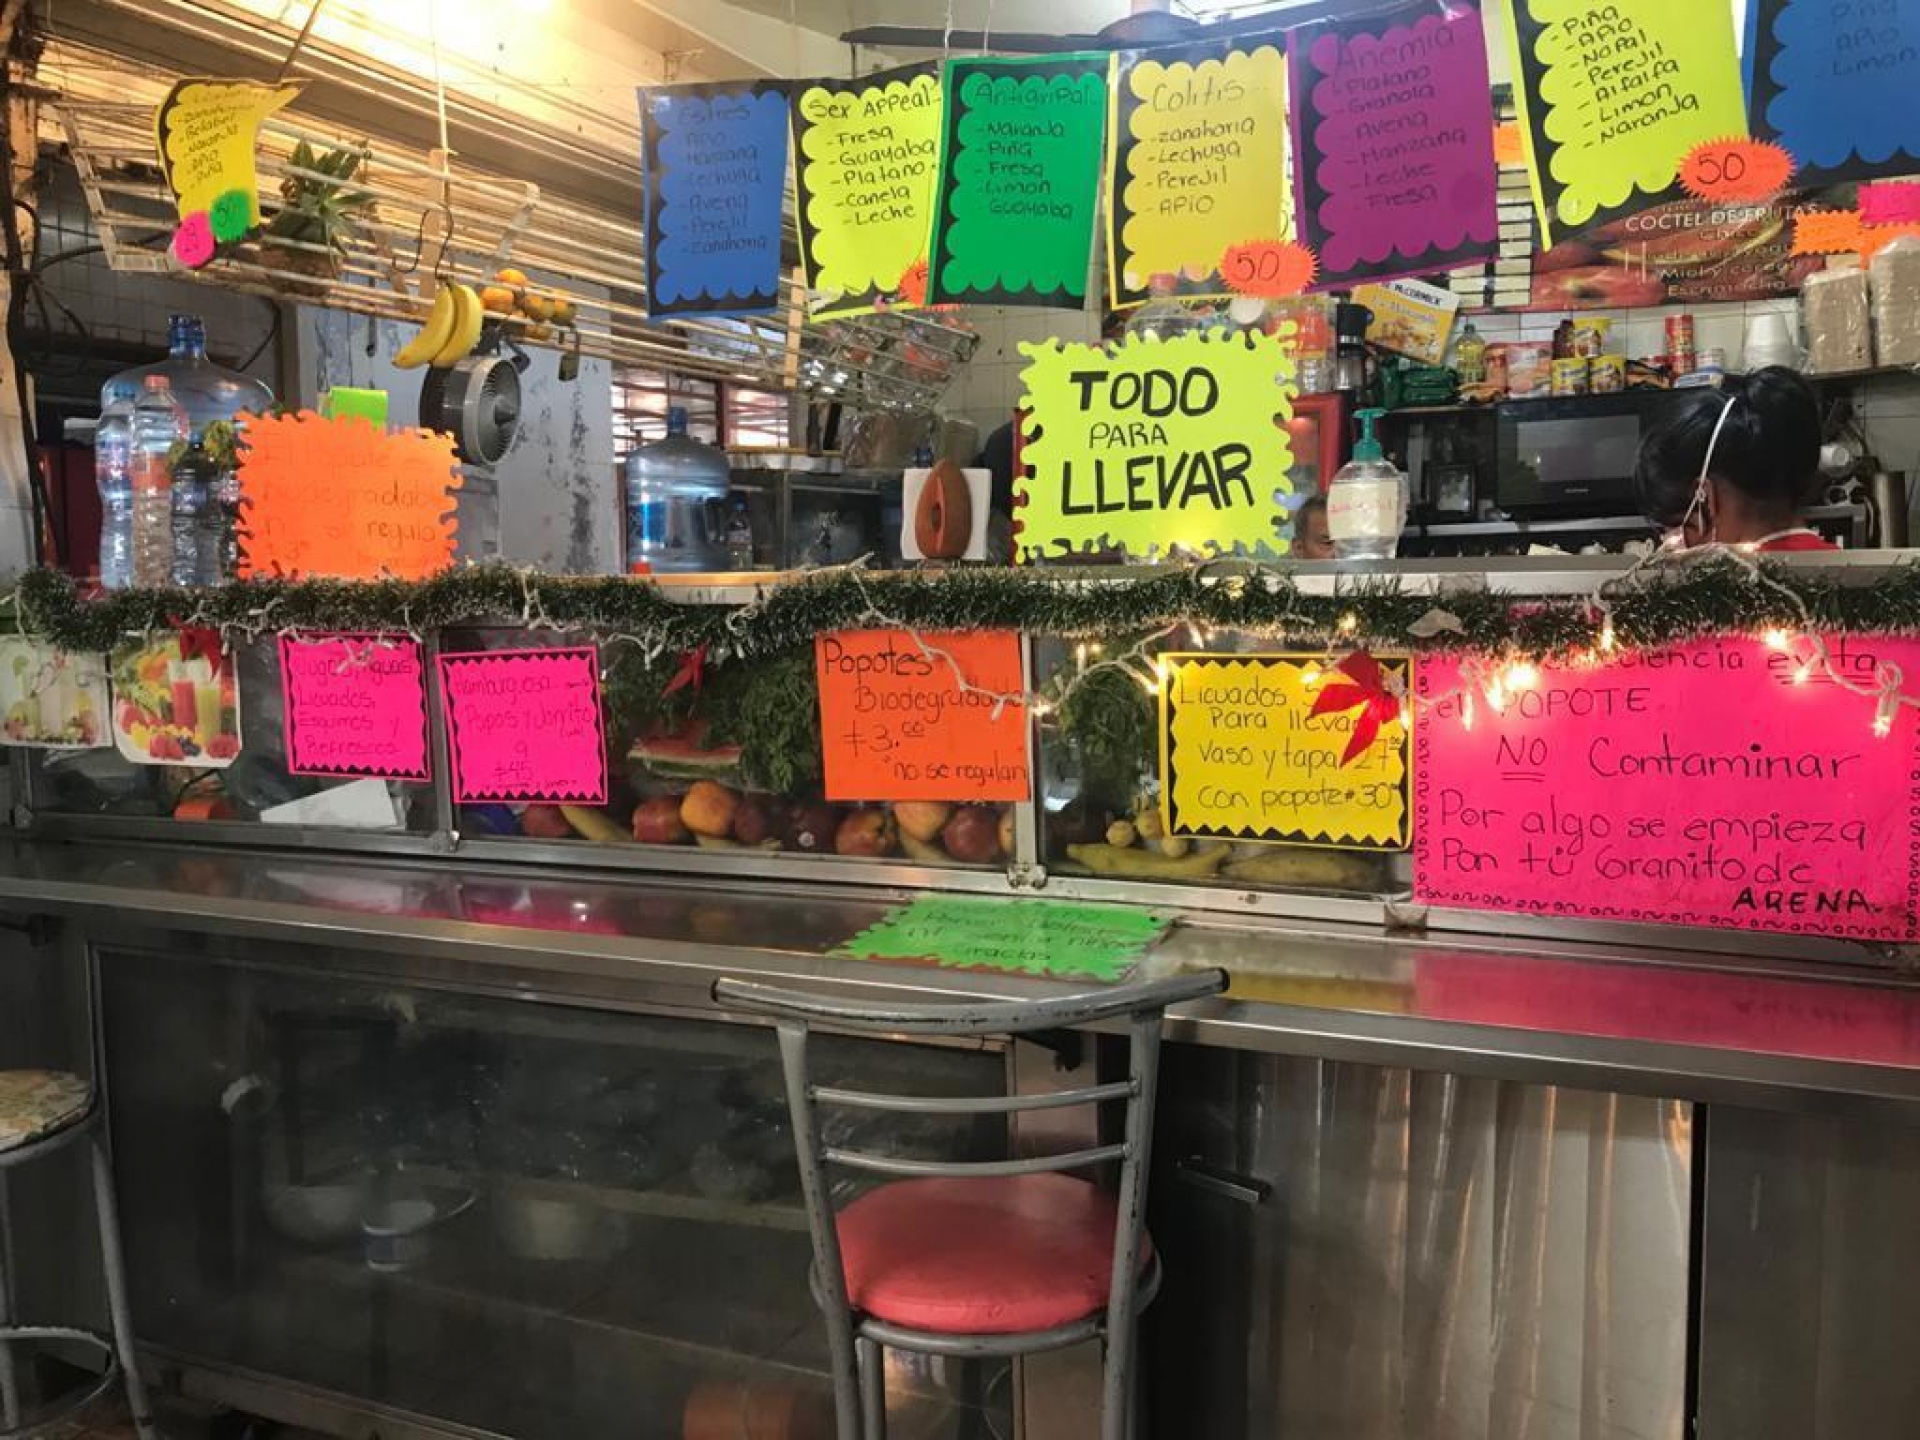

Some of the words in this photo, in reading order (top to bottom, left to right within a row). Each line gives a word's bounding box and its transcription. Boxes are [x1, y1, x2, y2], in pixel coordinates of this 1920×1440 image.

[809, 99, 852, 119] Sex
[1697, 152, 1745, 185] 50
[1625, 213, 1702, 232] COCTEL
[1236, 250, 1280, 284] 50
[1069, 366, 1219, 418] TODO
[1088, 421, 1168, 449] PARA
[1061, 442, 1255, 516] LLEVAR
[1180, 674, 1288, 708] Licuados
[1496, 733, 1549, 767] NO
[1589, 733, 1861, 780] Contaminar
[1440, 788, 1505, 830] Por
[1521, 795, 1613, 856] algo
[1628, 817, 1667, 839] se
[1683, 812, 1867, 852] empieza
